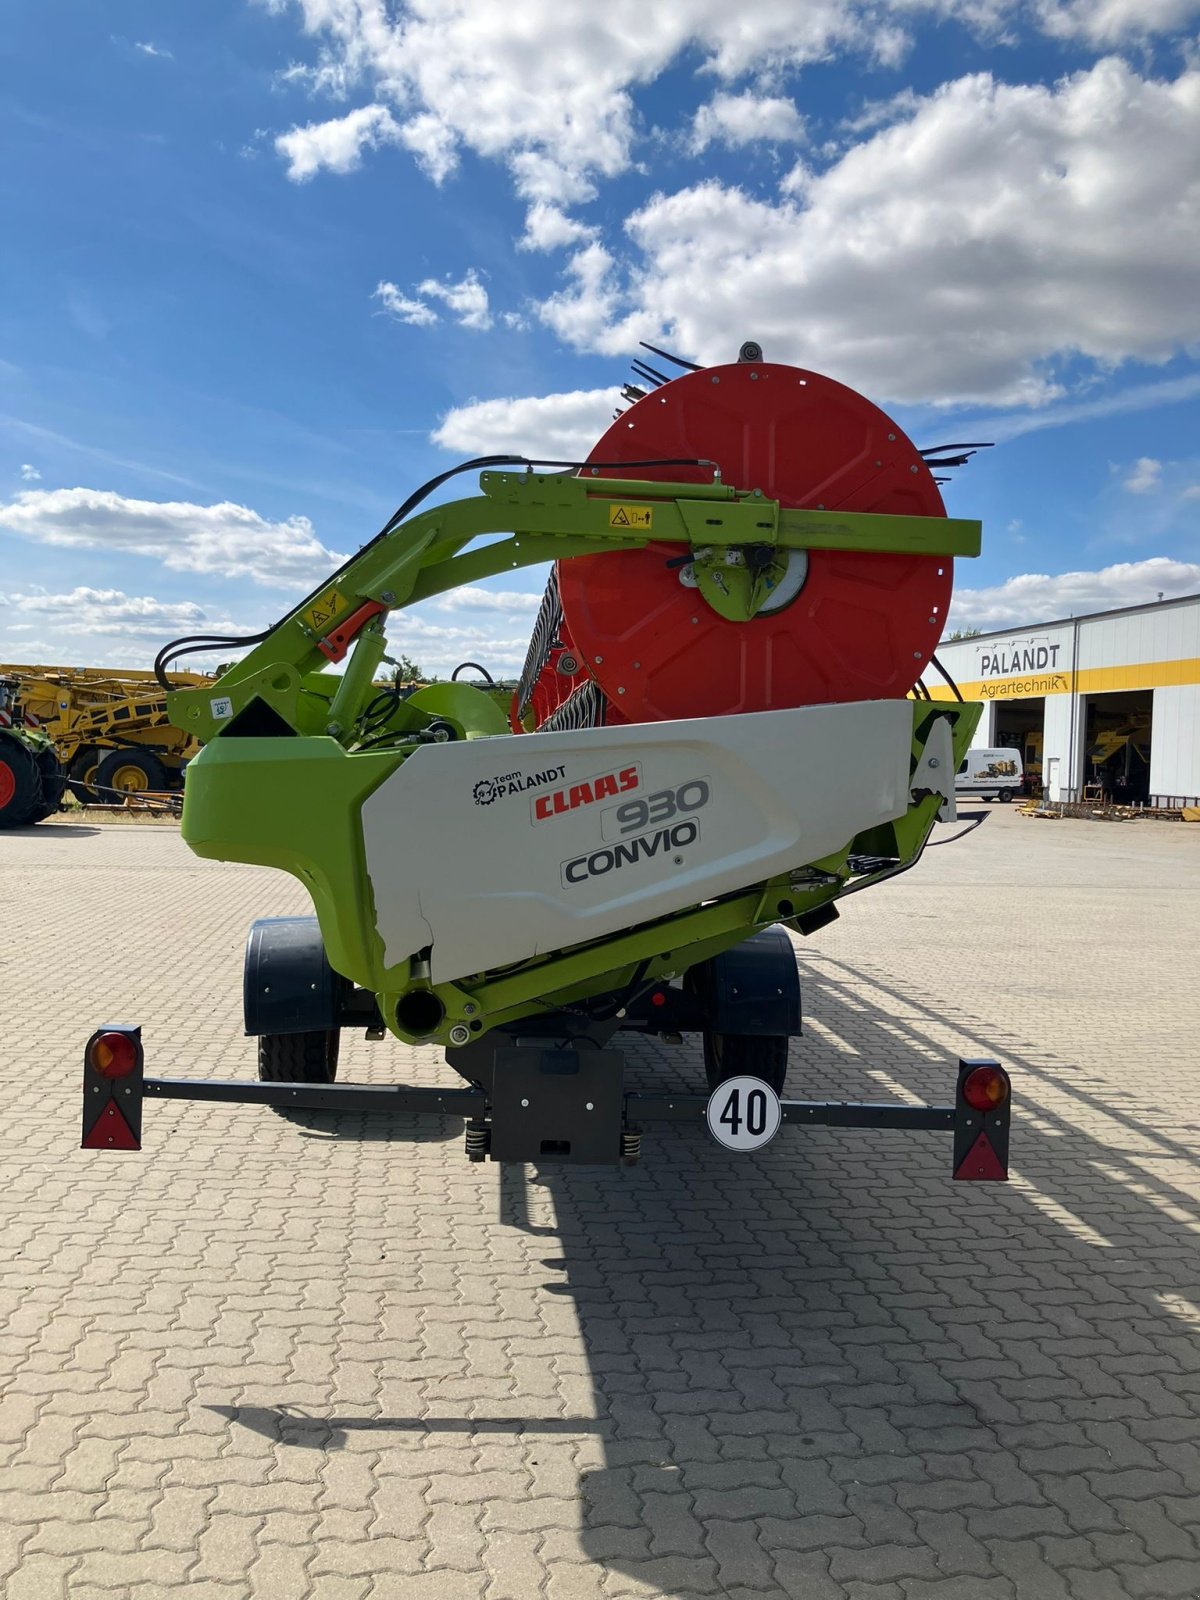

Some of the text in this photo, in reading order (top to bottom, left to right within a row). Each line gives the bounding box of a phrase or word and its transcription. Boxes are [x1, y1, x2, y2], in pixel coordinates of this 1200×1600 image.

[981, 645, 1060, 676] PALANDT
[980, 677, 1059, 697] Agrartechnik
[493, 771, 522, 784] Team
[497, 765, 566, 798] PALANDT
[535, 767, 639, 820] CLAAS
[616, 780, 709, 834] 930
[565, 822, 697, 883] CONVIO
[719, 1088, 767, 1136] 40
